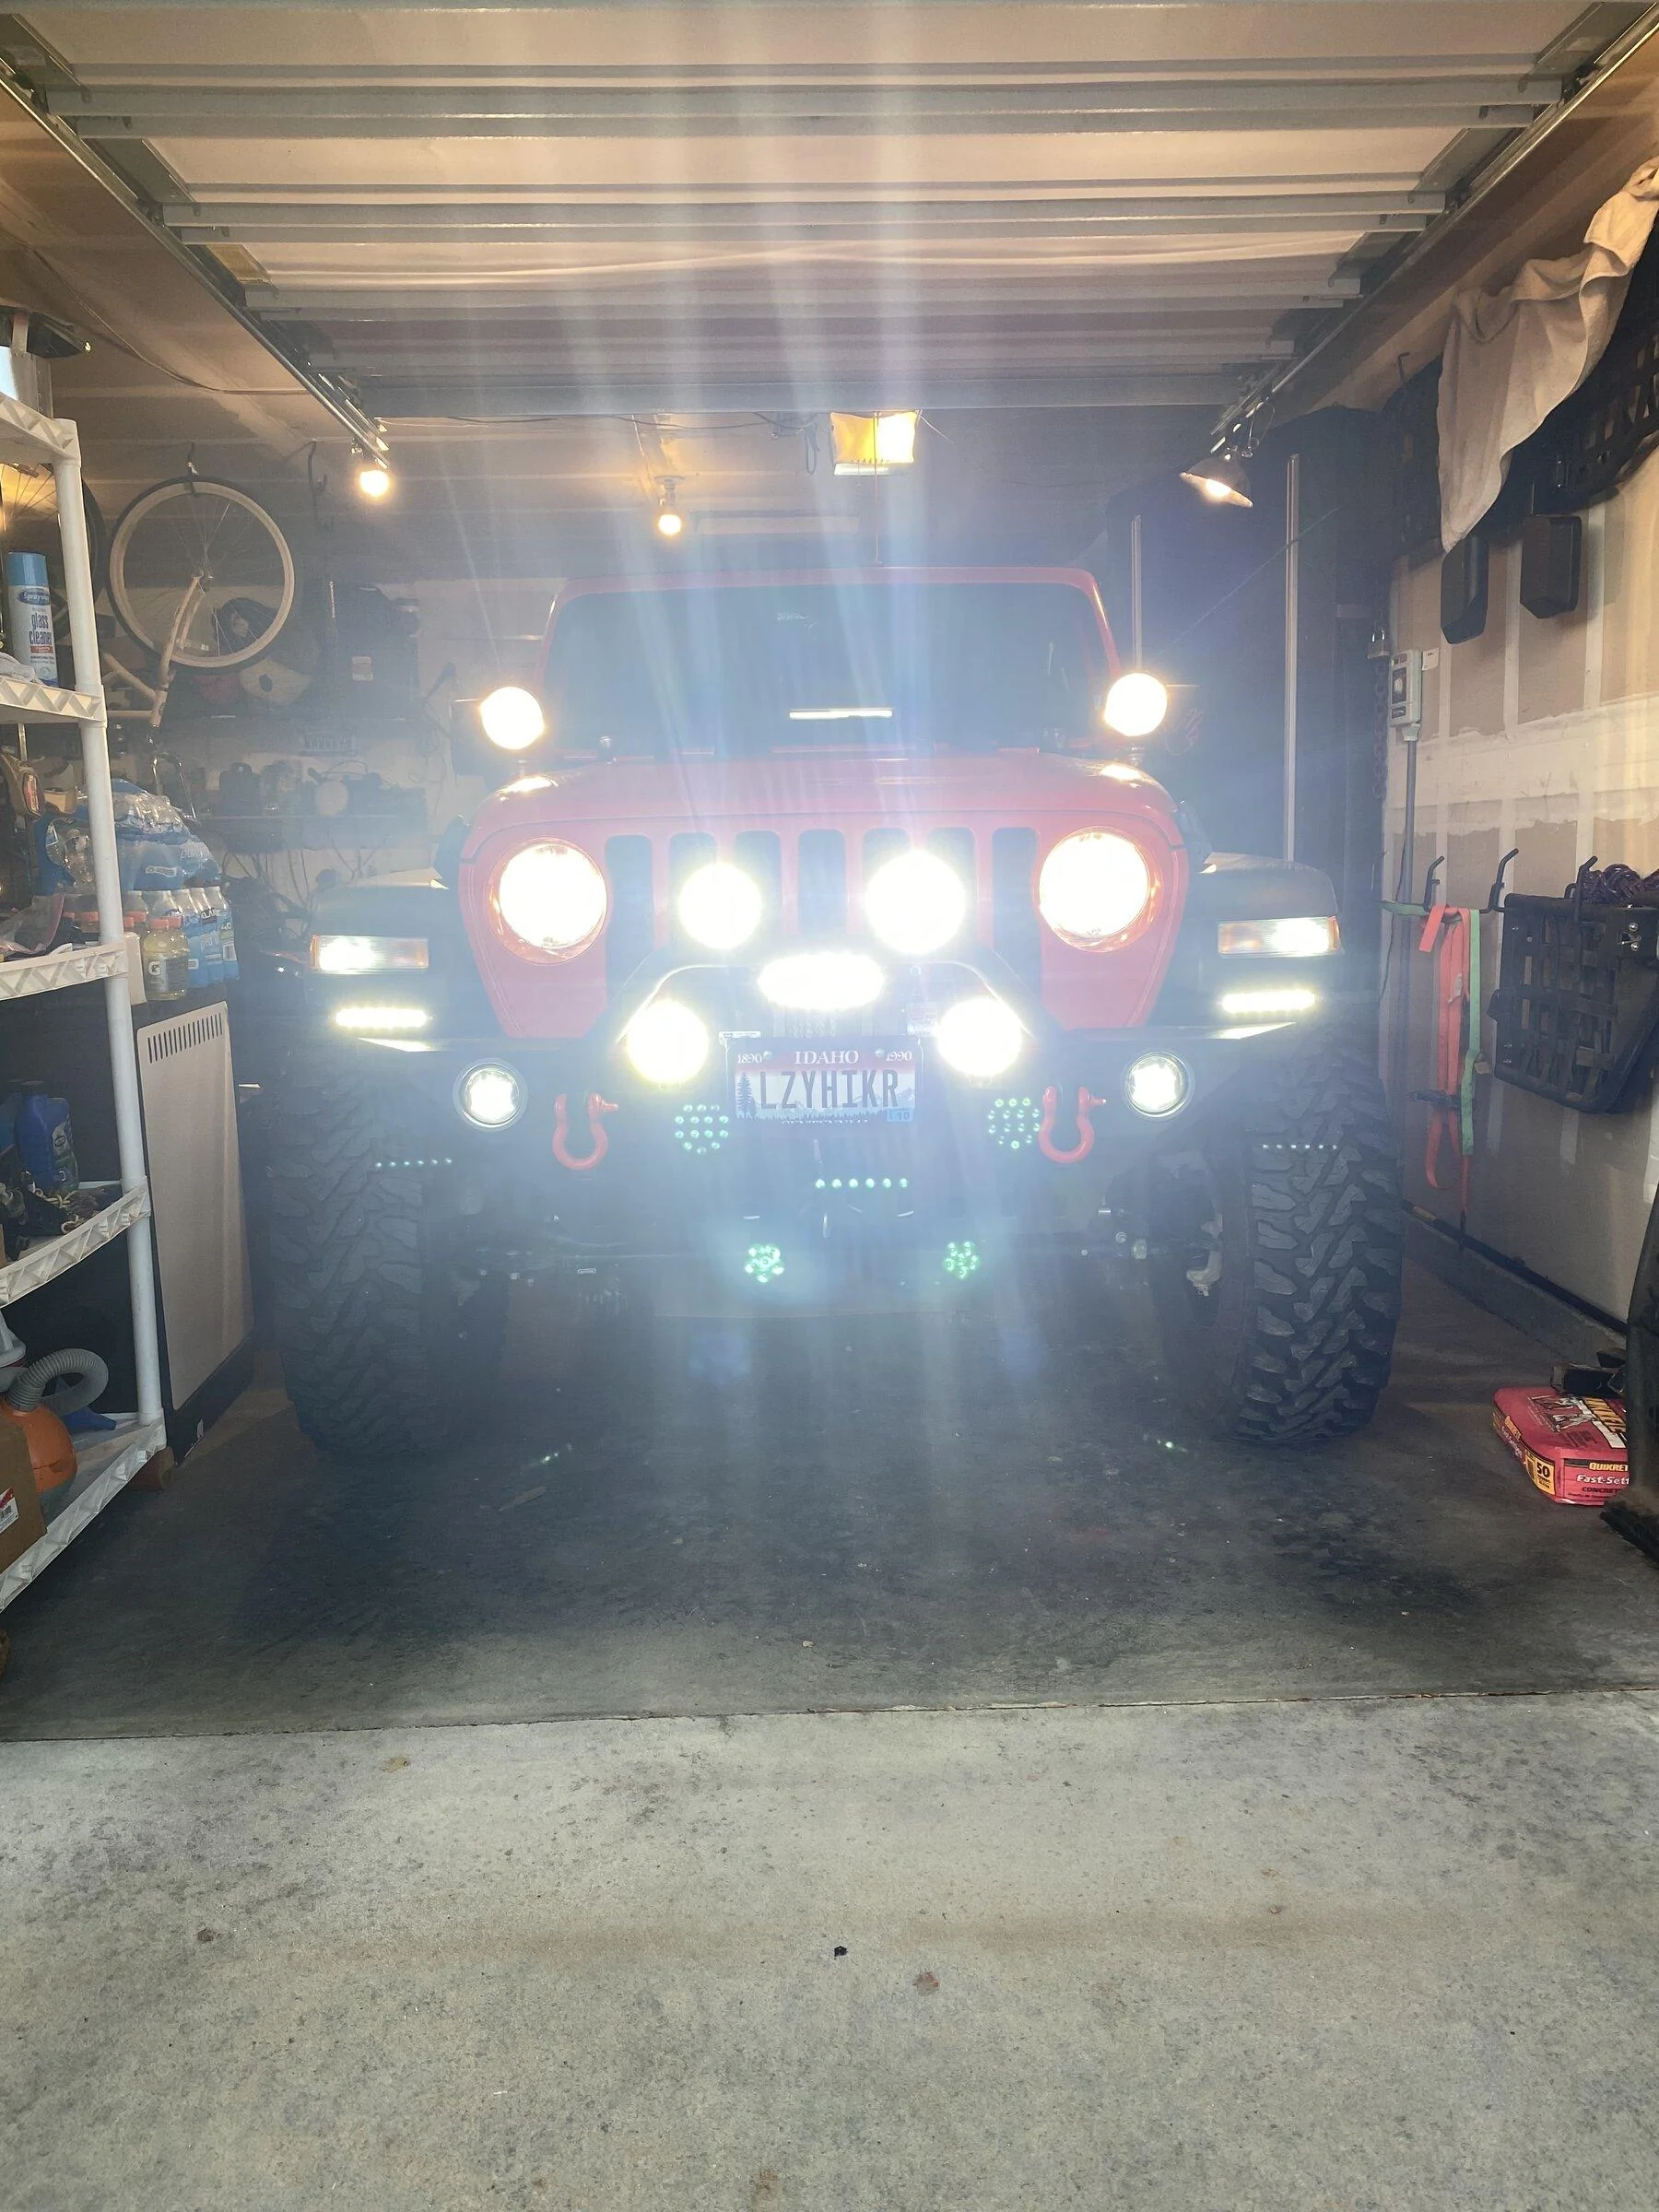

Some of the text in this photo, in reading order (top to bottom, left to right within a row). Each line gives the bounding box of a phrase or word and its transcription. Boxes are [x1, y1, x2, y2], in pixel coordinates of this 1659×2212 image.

[31, 612, 49, 629] glass
[29, 629, 53, 645] cleaner
[736, 1053, 763, 1065] 1890
[794, 1050, 860, 1065] IDAHO
[759, 1069, 900, 1110] LZYHIKR
[1536, 1462, 1550, 1477] 50
